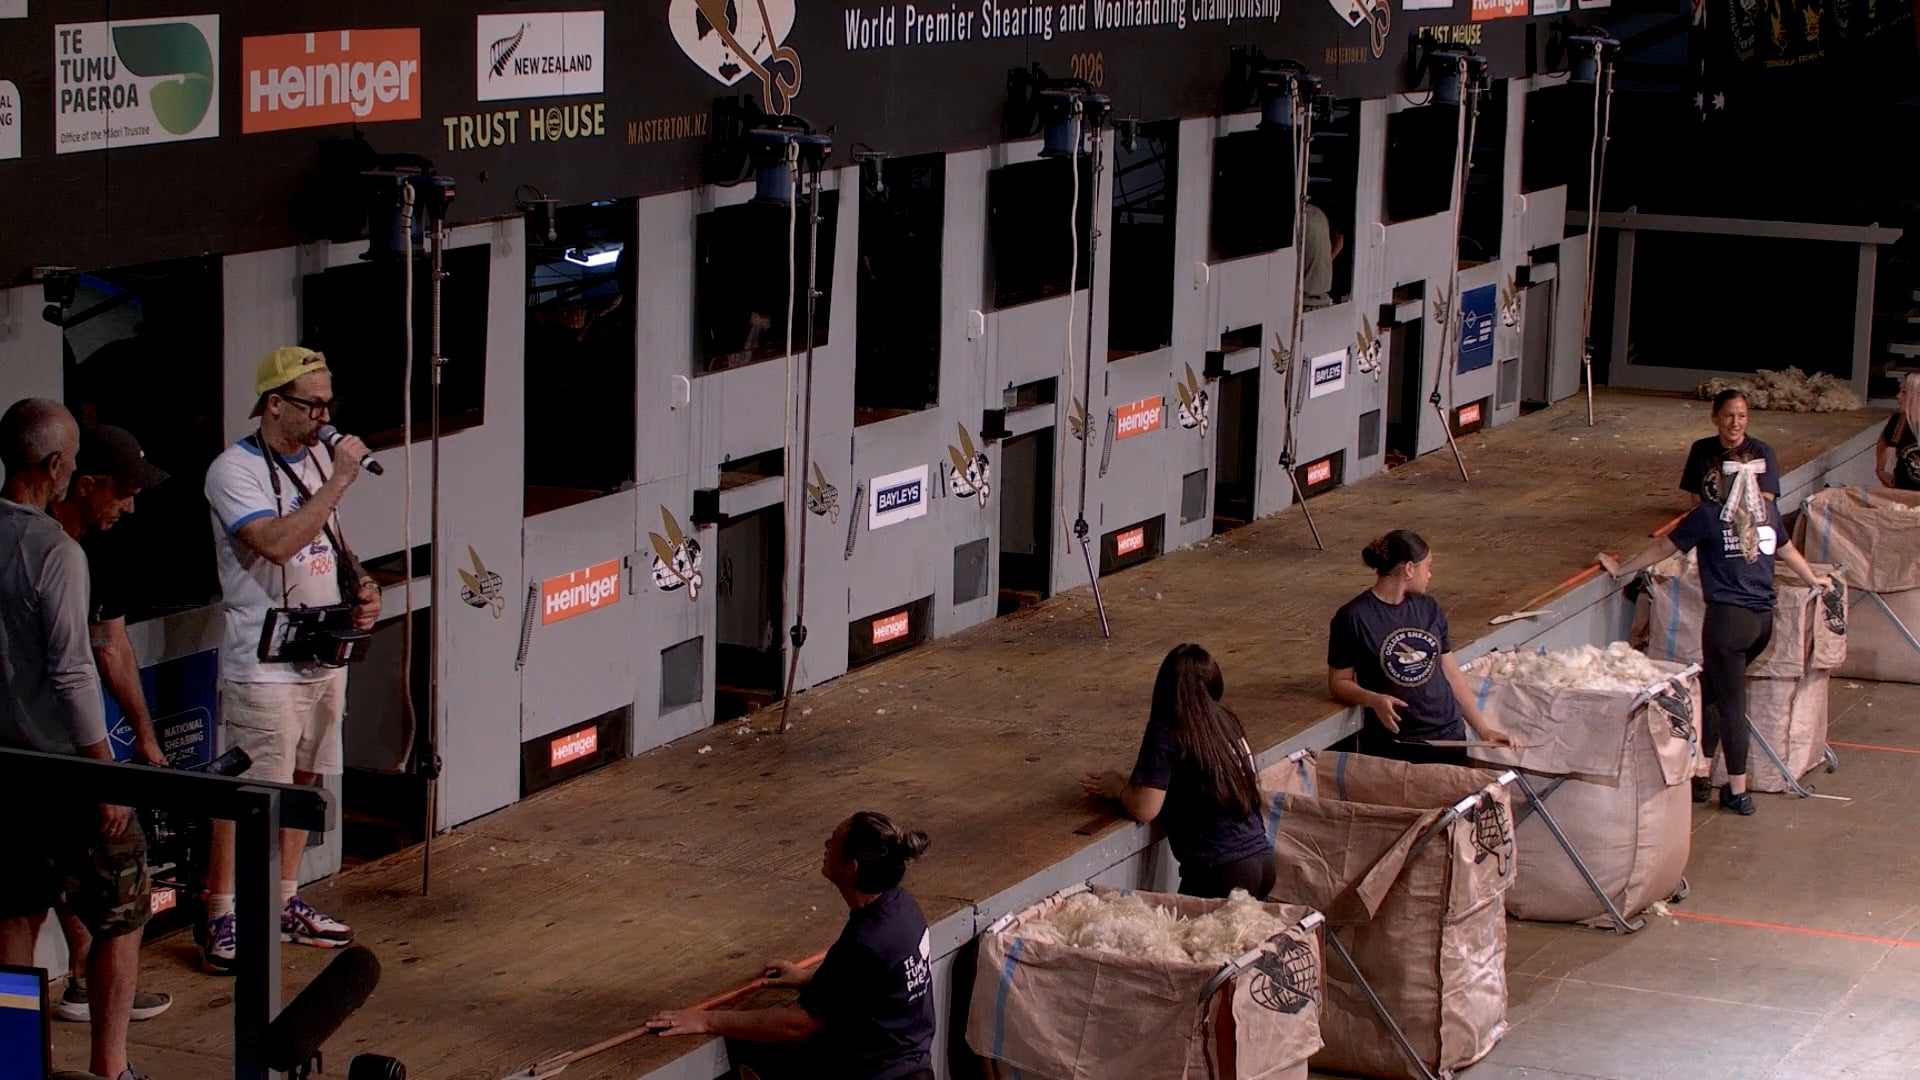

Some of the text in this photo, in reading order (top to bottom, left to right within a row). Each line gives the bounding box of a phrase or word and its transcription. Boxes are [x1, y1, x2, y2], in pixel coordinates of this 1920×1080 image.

[845, 6, 895, 50] World
[905, 4, 974, 45] Premier
[981, 0, 1053, 40] Shearing
[1059, 0, 1086, 32] and
[1093, 0, 1186, 30] Woolhandling
[60, 30, 82, 55] TE
[60, 56, 117, 84] TUMU
[250, 31, 417, 116] Heiniger
[514, 54, 592, 76] NEW ZEALAND
[1070, 51, 1104, 88] 2026
[61, 83, 139, 114] PAEROA
[61, 132, 80, 144] Office
[82, 131, 89, 142] of
[91, 129, 102, 140] the
[124, 126, 150, 137] Trustee
[443, 103, 606, 150] TRUST HOUSE
[628, 112, 709, 145] MASTERTON.NZ
[1316, 364, 1341, 383] BAYLEYS
[1118, 400, 1161, 434] Heiniger
[878, 485, 920, 510] BAYLEYS
[546, 567, 618, 615] Heiniger
[874, 616, 908, 639] Heiniger
[1385, 631, 1437, 656] GOLDEN SHEARS
[164, 718, 204, 738] NATIONAL
[553, 732, 597, 761] Heiniger
[904, 955, 915, 970] TE
